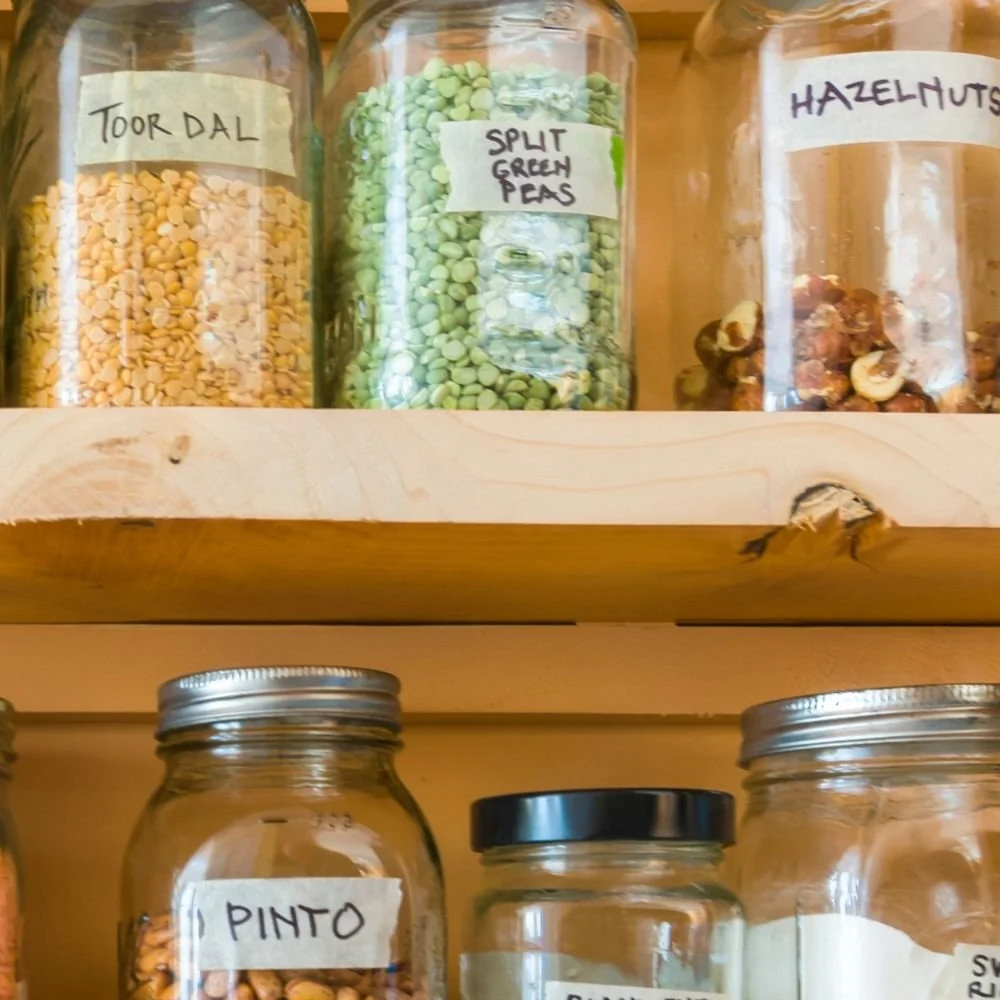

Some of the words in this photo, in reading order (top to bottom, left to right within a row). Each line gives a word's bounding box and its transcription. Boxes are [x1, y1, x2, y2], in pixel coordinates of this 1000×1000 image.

[791, 76, 1000, 119] HAZELNUTS
[183, 112, 259, 143] DAL
[485, 127, 567, 154] SPLIT
[491, 155, 572, 180] GREEN
[499, 179, 576, 207] PEAS
[226, 901, 365, 941] PINTO
